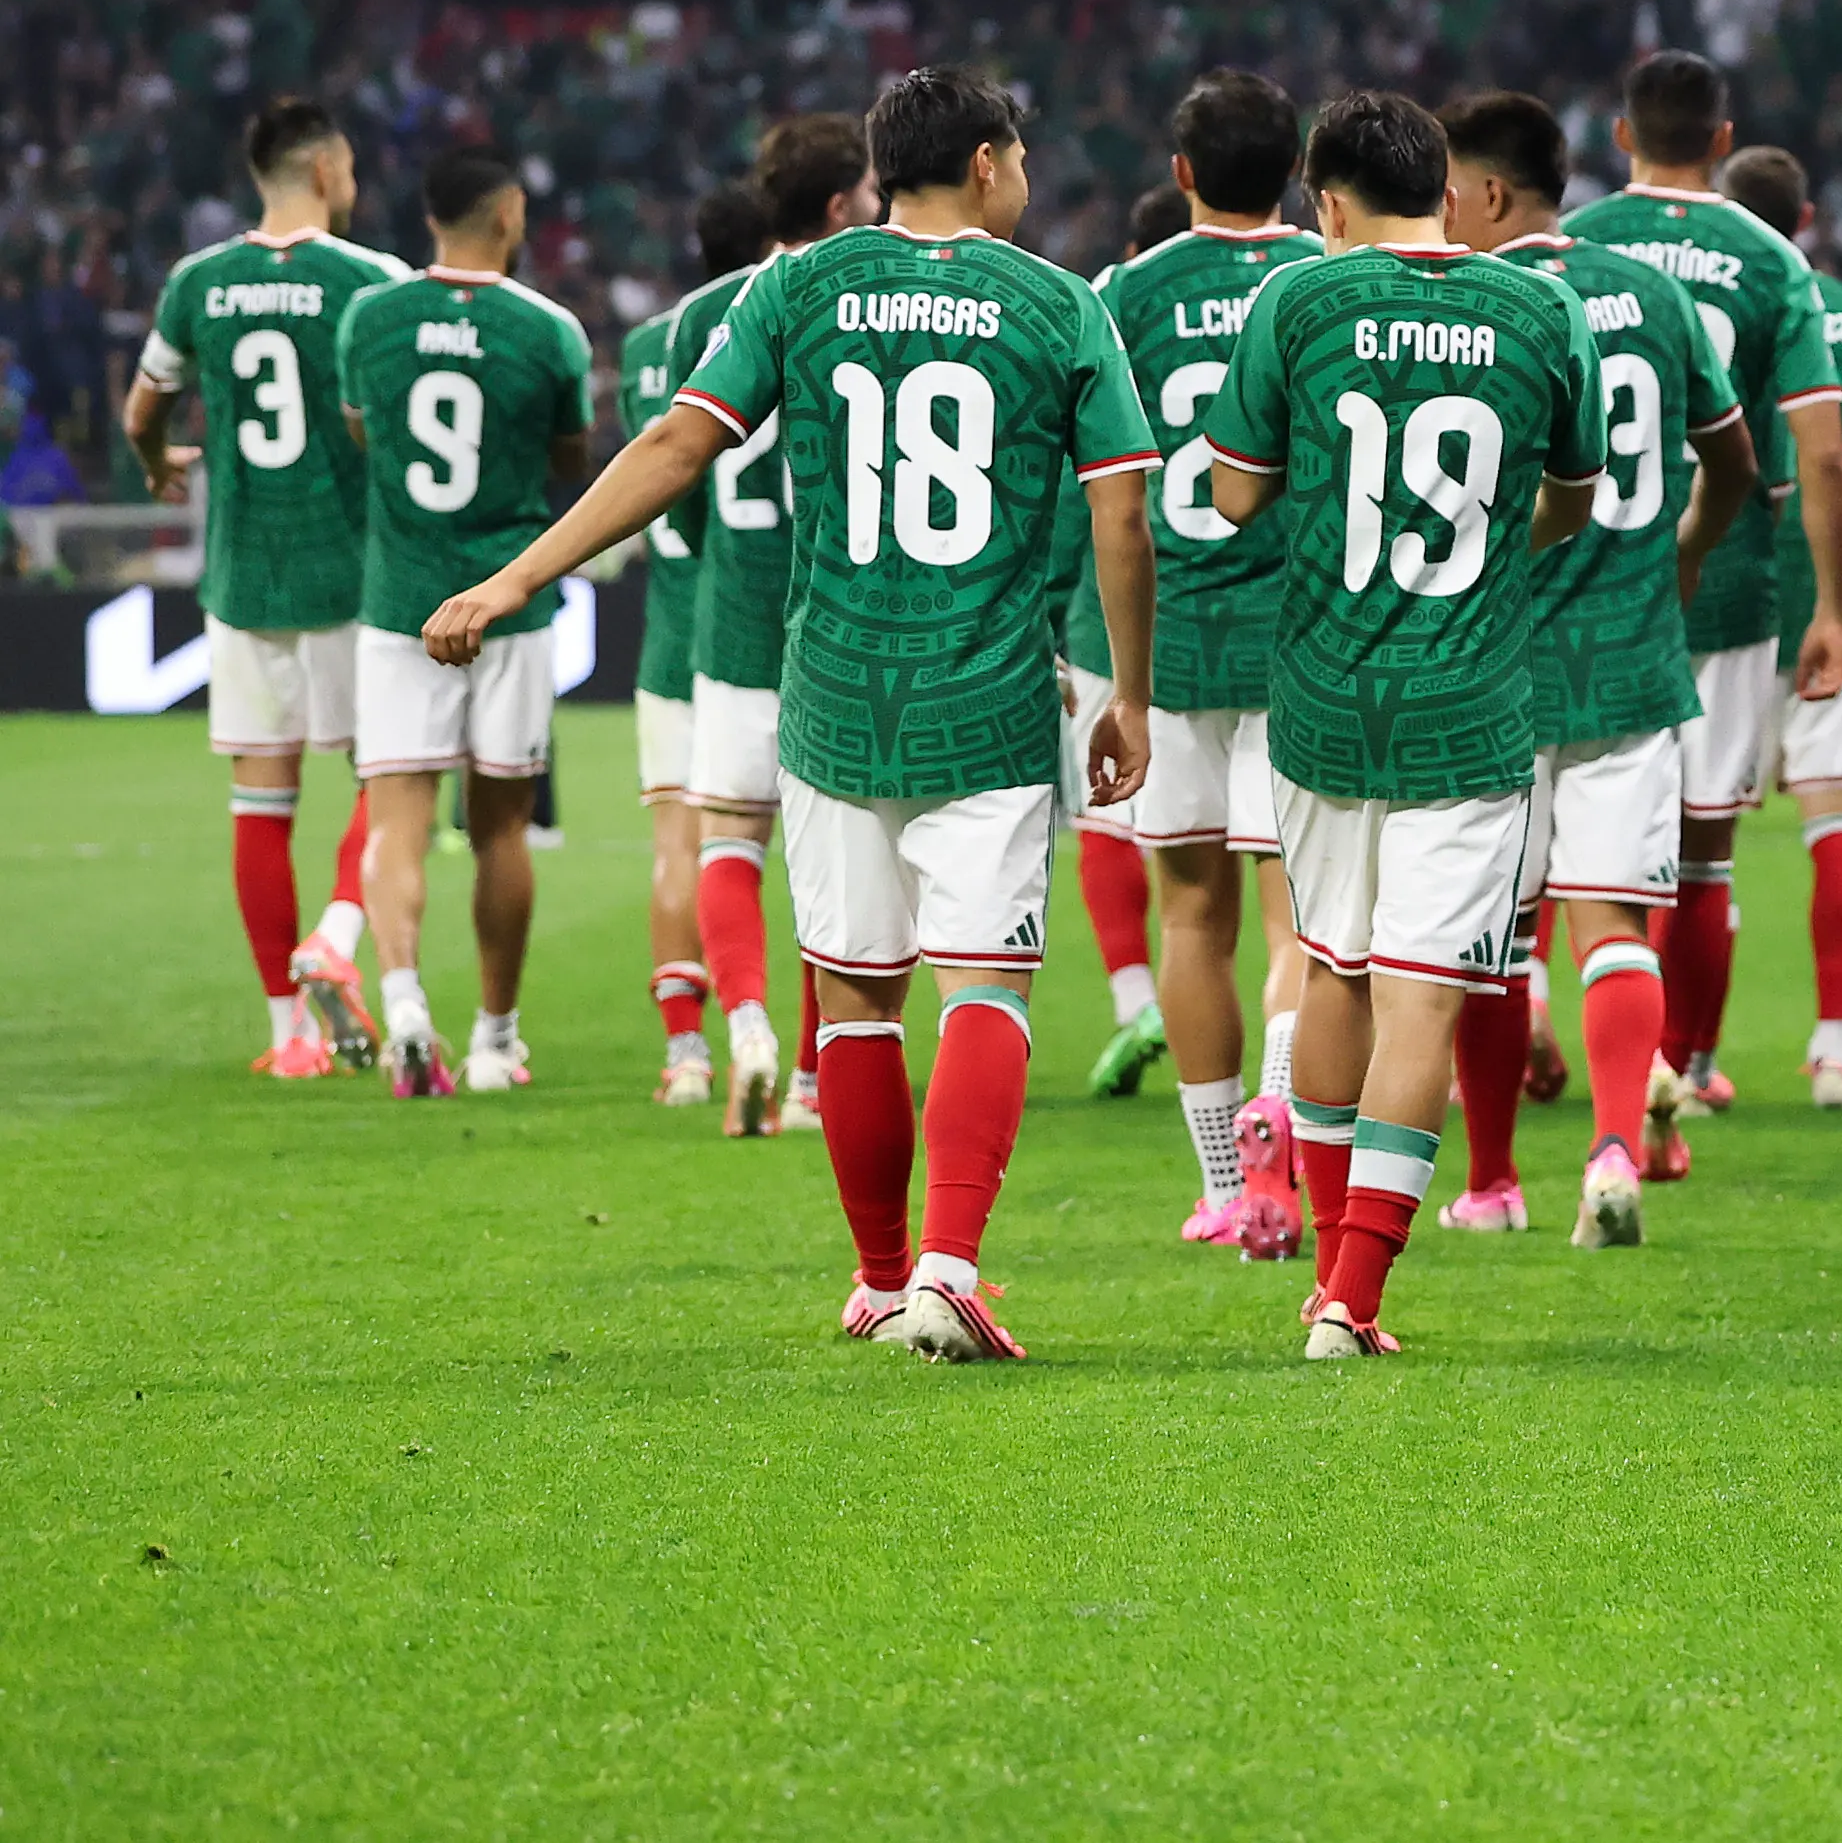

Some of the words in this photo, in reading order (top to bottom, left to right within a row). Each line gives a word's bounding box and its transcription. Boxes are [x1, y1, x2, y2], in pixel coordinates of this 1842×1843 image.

[837, 292, 1002, 339] O.VARGAS
[1354, 318, 1495, 367] G.MORA
[231, 330, 307, 469] 3
[405, 370, 485, 513] 9
[832, 360, 995, 566] 18
[1160, 360, 1241, 541] 2
[1592, 352, 1664, 531] 3
[1336, 391, 1504, 597] 19
